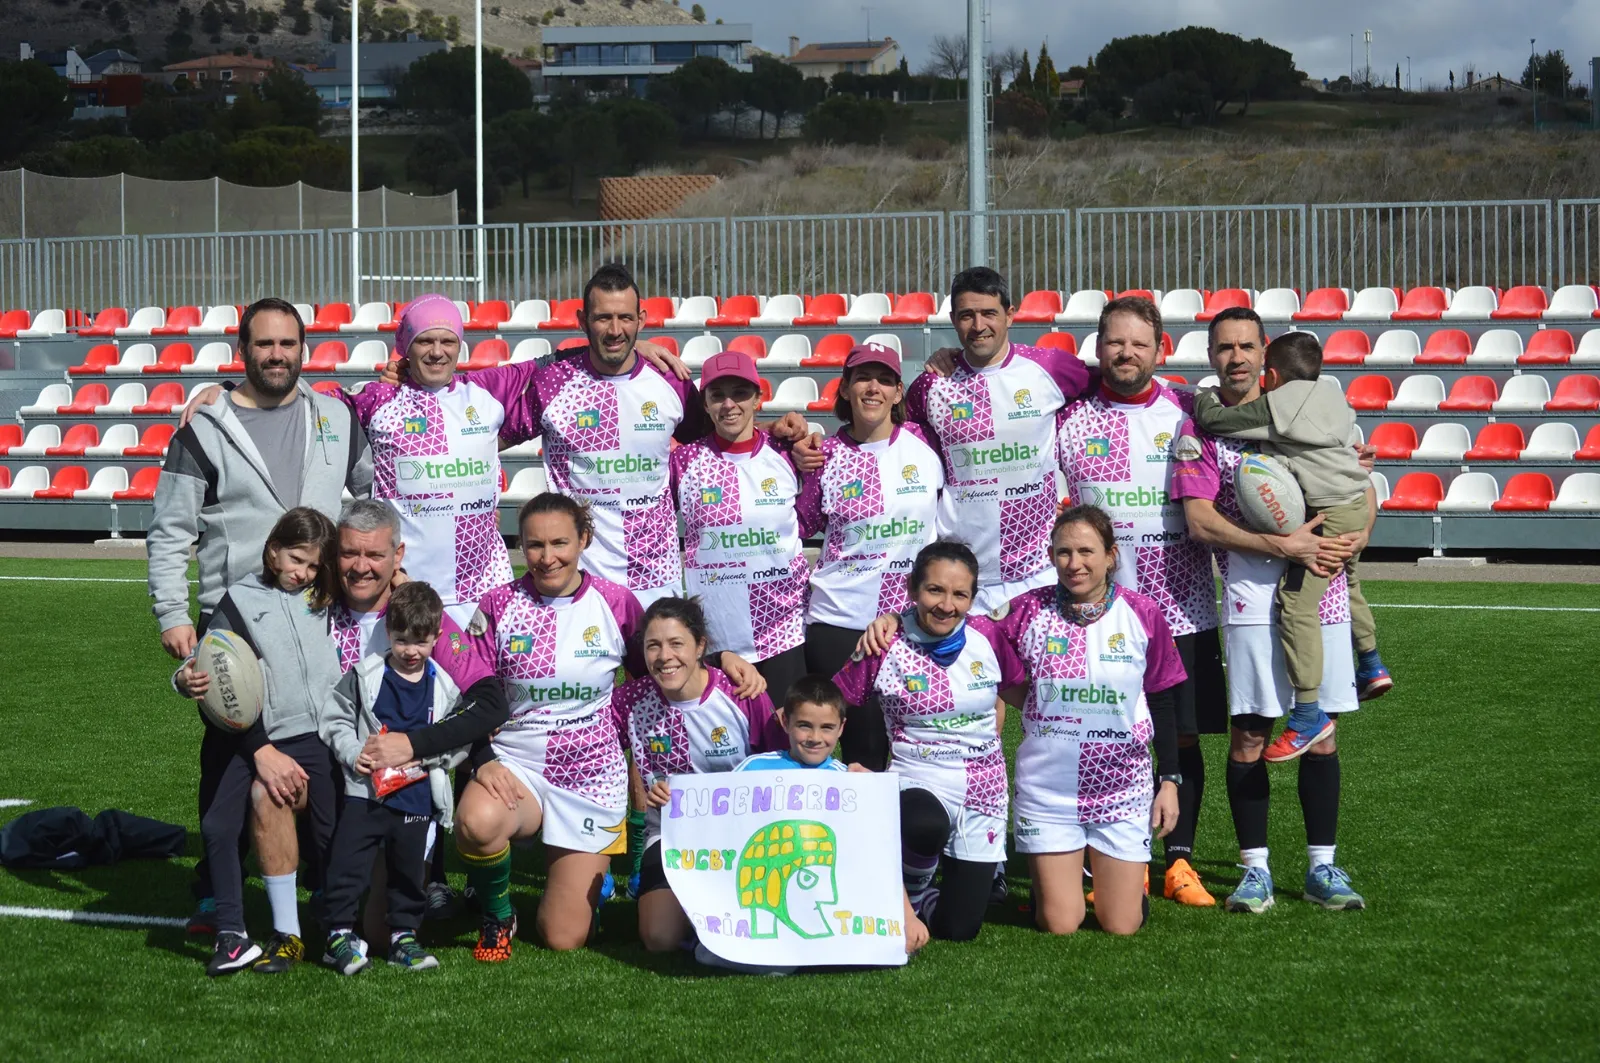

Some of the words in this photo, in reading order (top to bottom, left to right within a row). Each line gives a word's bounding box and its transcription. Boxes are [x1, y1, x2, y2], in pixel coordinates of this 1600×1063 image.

[870, 343, 885, 353] N
[596, 454, 660, 474] trebia+
[972, 442, 1039, 465] trebia+
[425, 457, 491, 479] trebia+
[1005, 482, 1042, 496] molher
[1105, 486, 1170, 507] trebia
[460, 498, 493, 511] molher
[1256, 482, 1289, 529] TOUCH
[720, 527, 780, 549] trebia+
[865, 517, 925, 540] trebia+
[1142, 531, 1184, 542] molher
[753, 567, 790, 579] molher
[890, 558, 914, 568] molh
[529, 682, 602, 702] trebia+
[1060, 683, 1127, 705] trebia+
[1087, 728, 1131, 739] molher
[664, 848, 737, 871] RUGBY
[690, 910, 751, 938] ORIA
[833, 910, 902, 936] TOUCH
